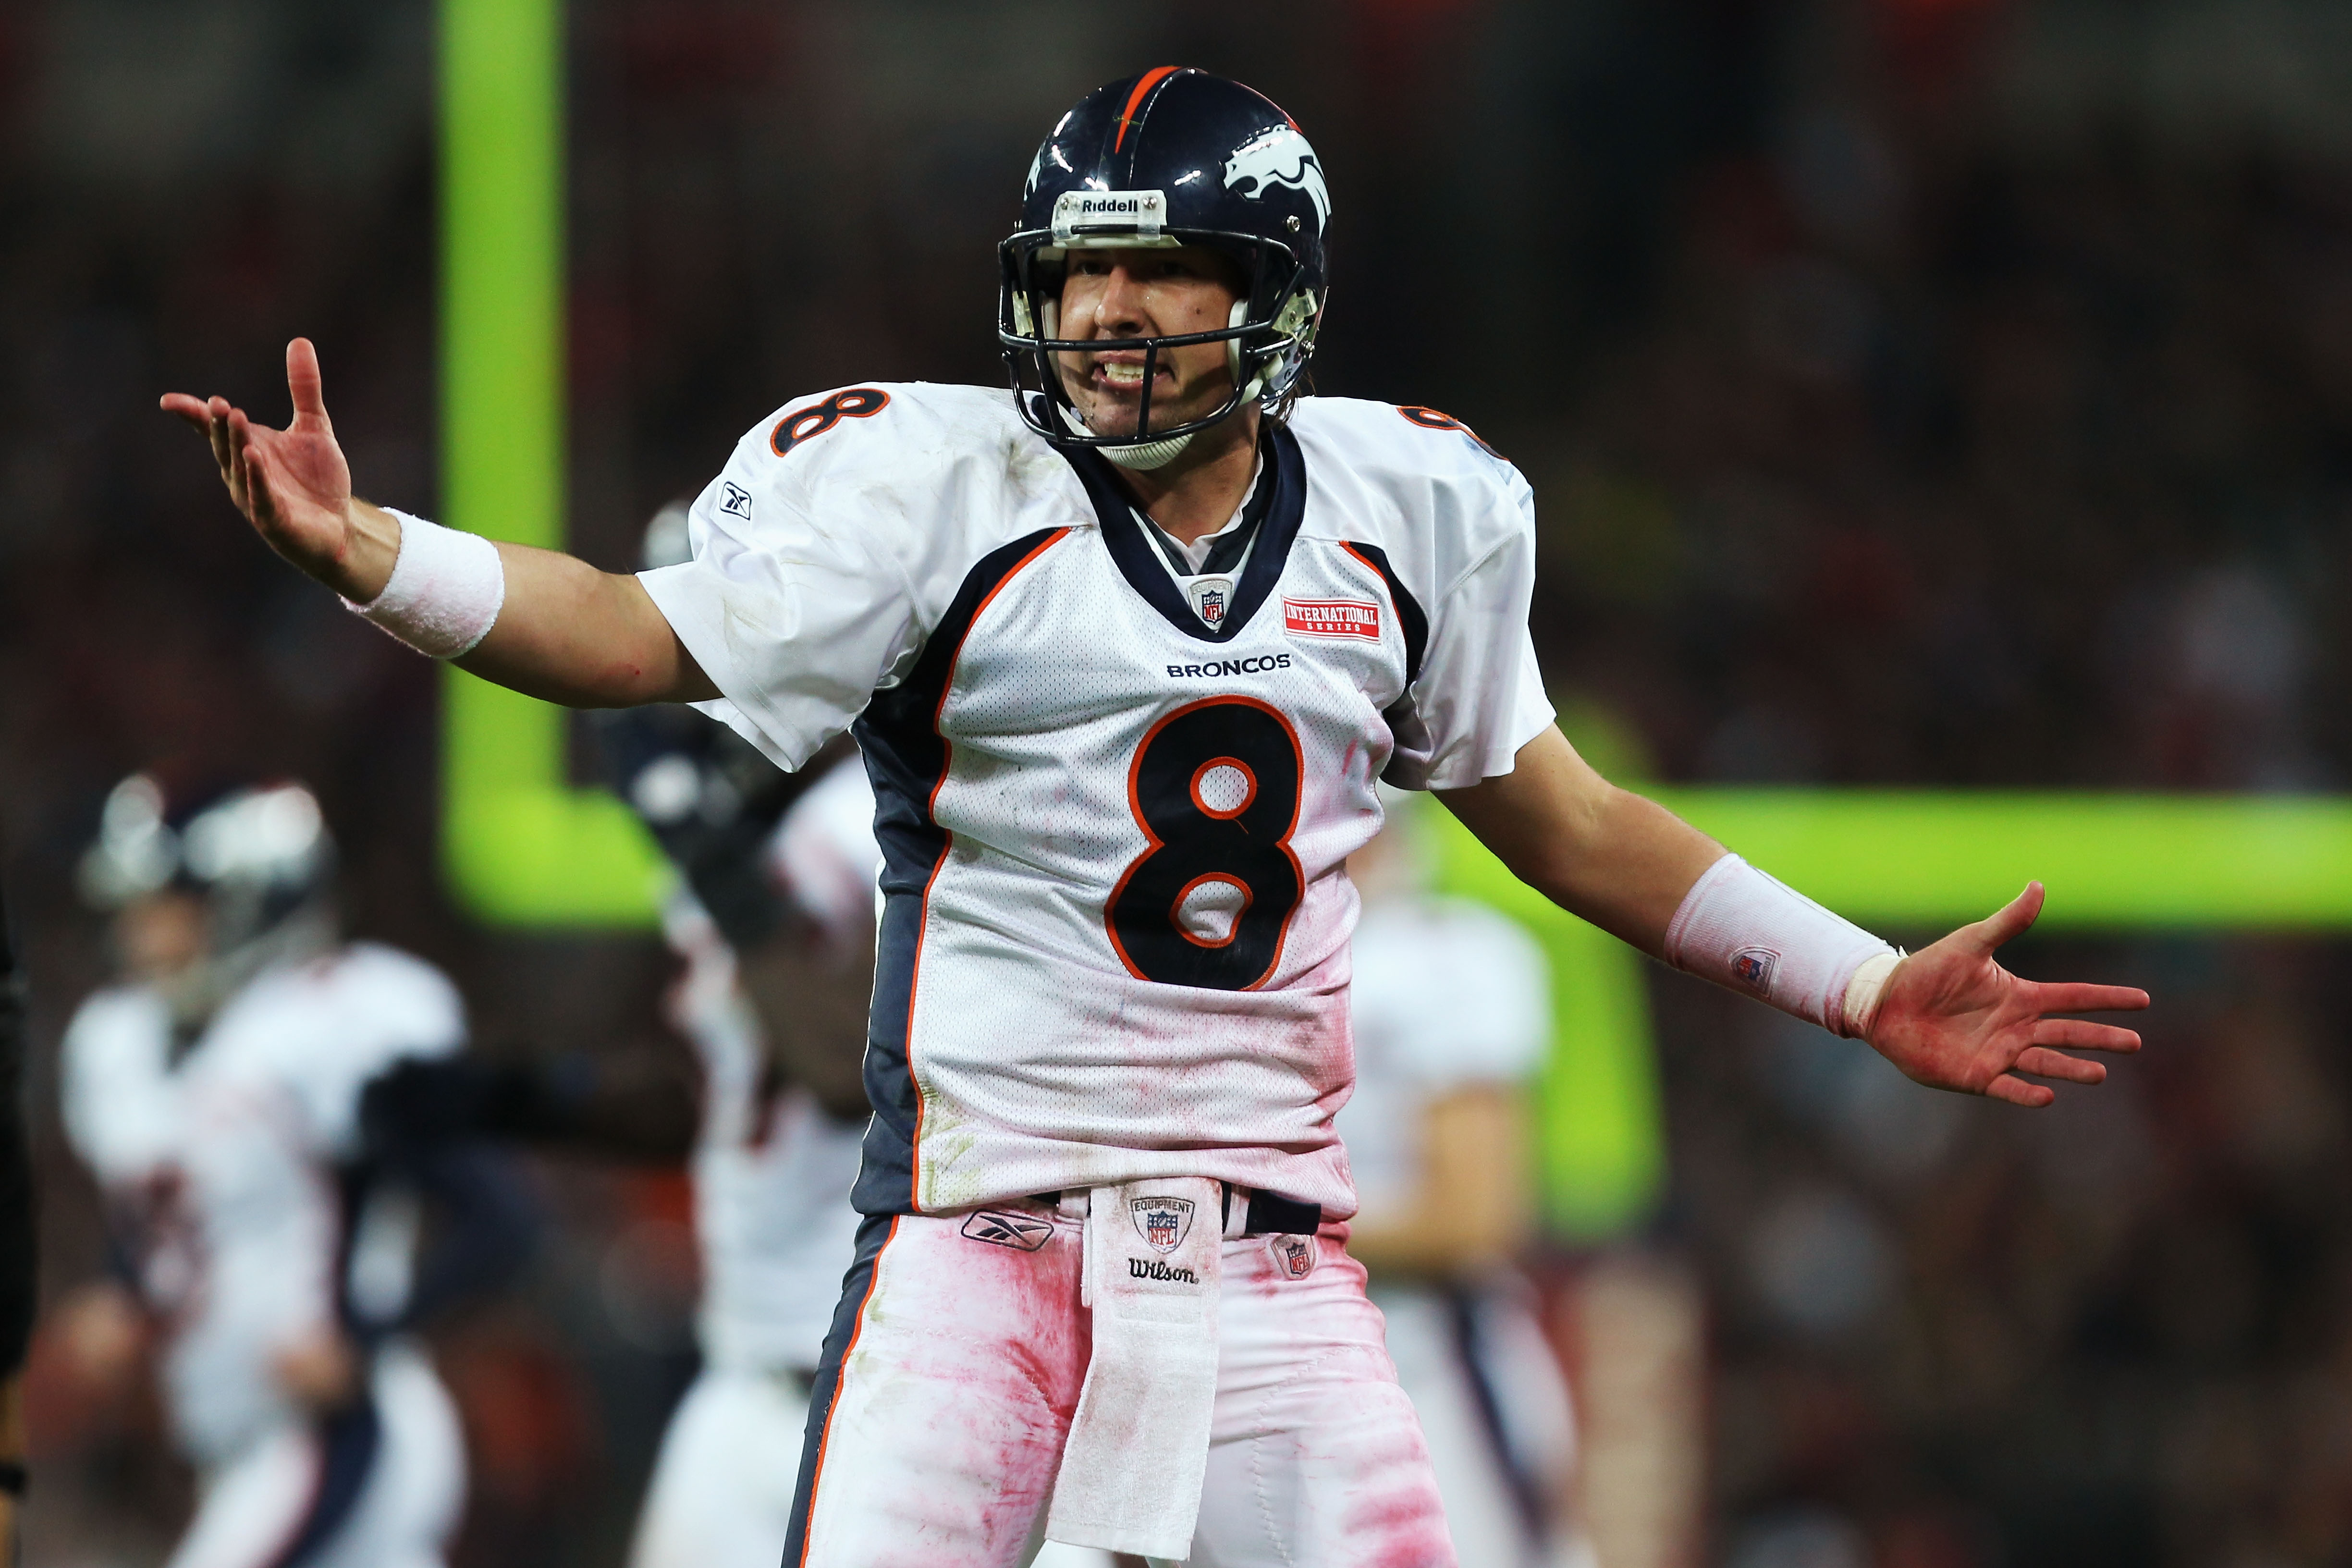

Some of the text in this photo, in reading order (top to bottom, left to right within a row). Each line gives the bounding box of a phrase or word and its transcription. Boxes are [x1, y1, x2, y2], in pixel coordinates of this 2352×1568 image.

[1082, 199, 1138, 212] Riddell
[770, 388, 890, 458] 8
[1204, 604, 1223, 620] NFL
[1285, 603, 1377, 625] INTERNATIONAL
[1307, 622, 1360, 632] SERIES
[1167, 654, 1291, 677] BRONCOS
[1104, 694, 1305, 991] 8
[1135, 1200, 1190, 1213] EQUIPMENT
[1149, 1227, 1174, 1246] NFL
[1128, 1257, 1196, 1284] Wilson
[1291, 1254, 1309, 1272] NFL
